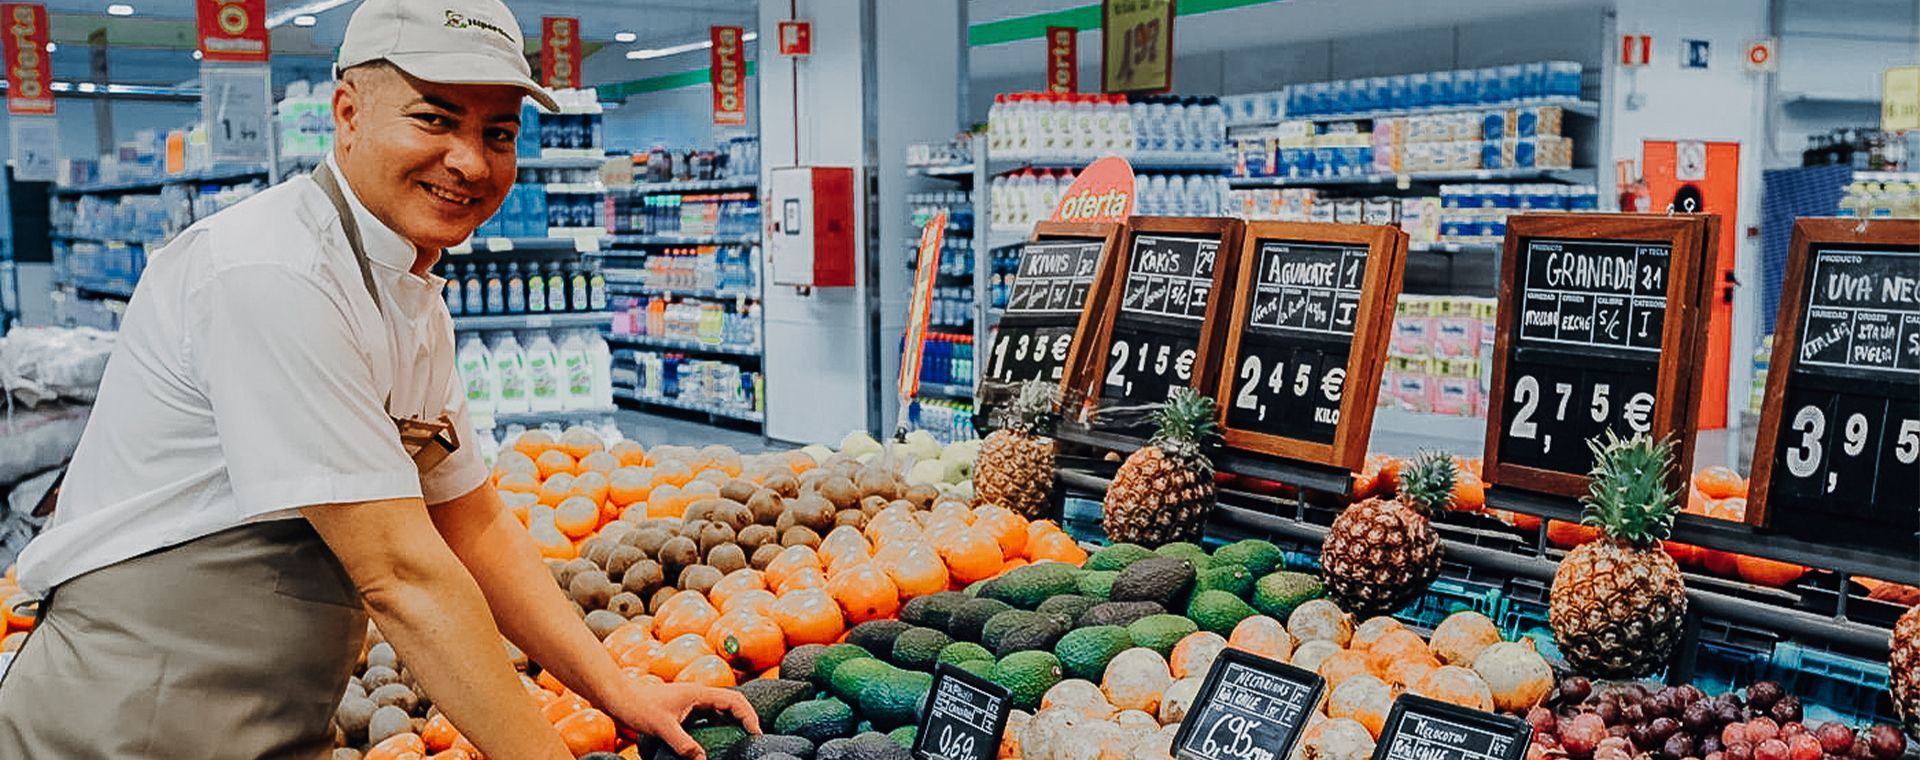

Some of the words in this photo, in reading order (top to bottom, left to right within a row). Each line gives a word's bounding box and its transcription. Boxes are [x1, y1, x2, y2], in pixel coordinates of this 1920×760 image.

[11, 6, 41, 97] oferta
[549, 20, 571, 87] ferta
[1052, 31, 1070, 93] ferta
[718, 28, 737, 111] oferta
[1061, 189, 1127, 220] oferta
[1028, 254, 1070, 277] KIWIS
[1344, 259, 1360, 289] 1
[1546, 252, 1635, 291] GRANADA
[1820, 255, 1862, 264] PRODUCTO
[1641, 264, 1662, 290] 21
[1828, 272, 1873, 301] UVA
[1599, 309, 1620, 340] S/C
[1314, 407, 1341, 425] KILO
[1202, 713, 1263, 758] 6,95
